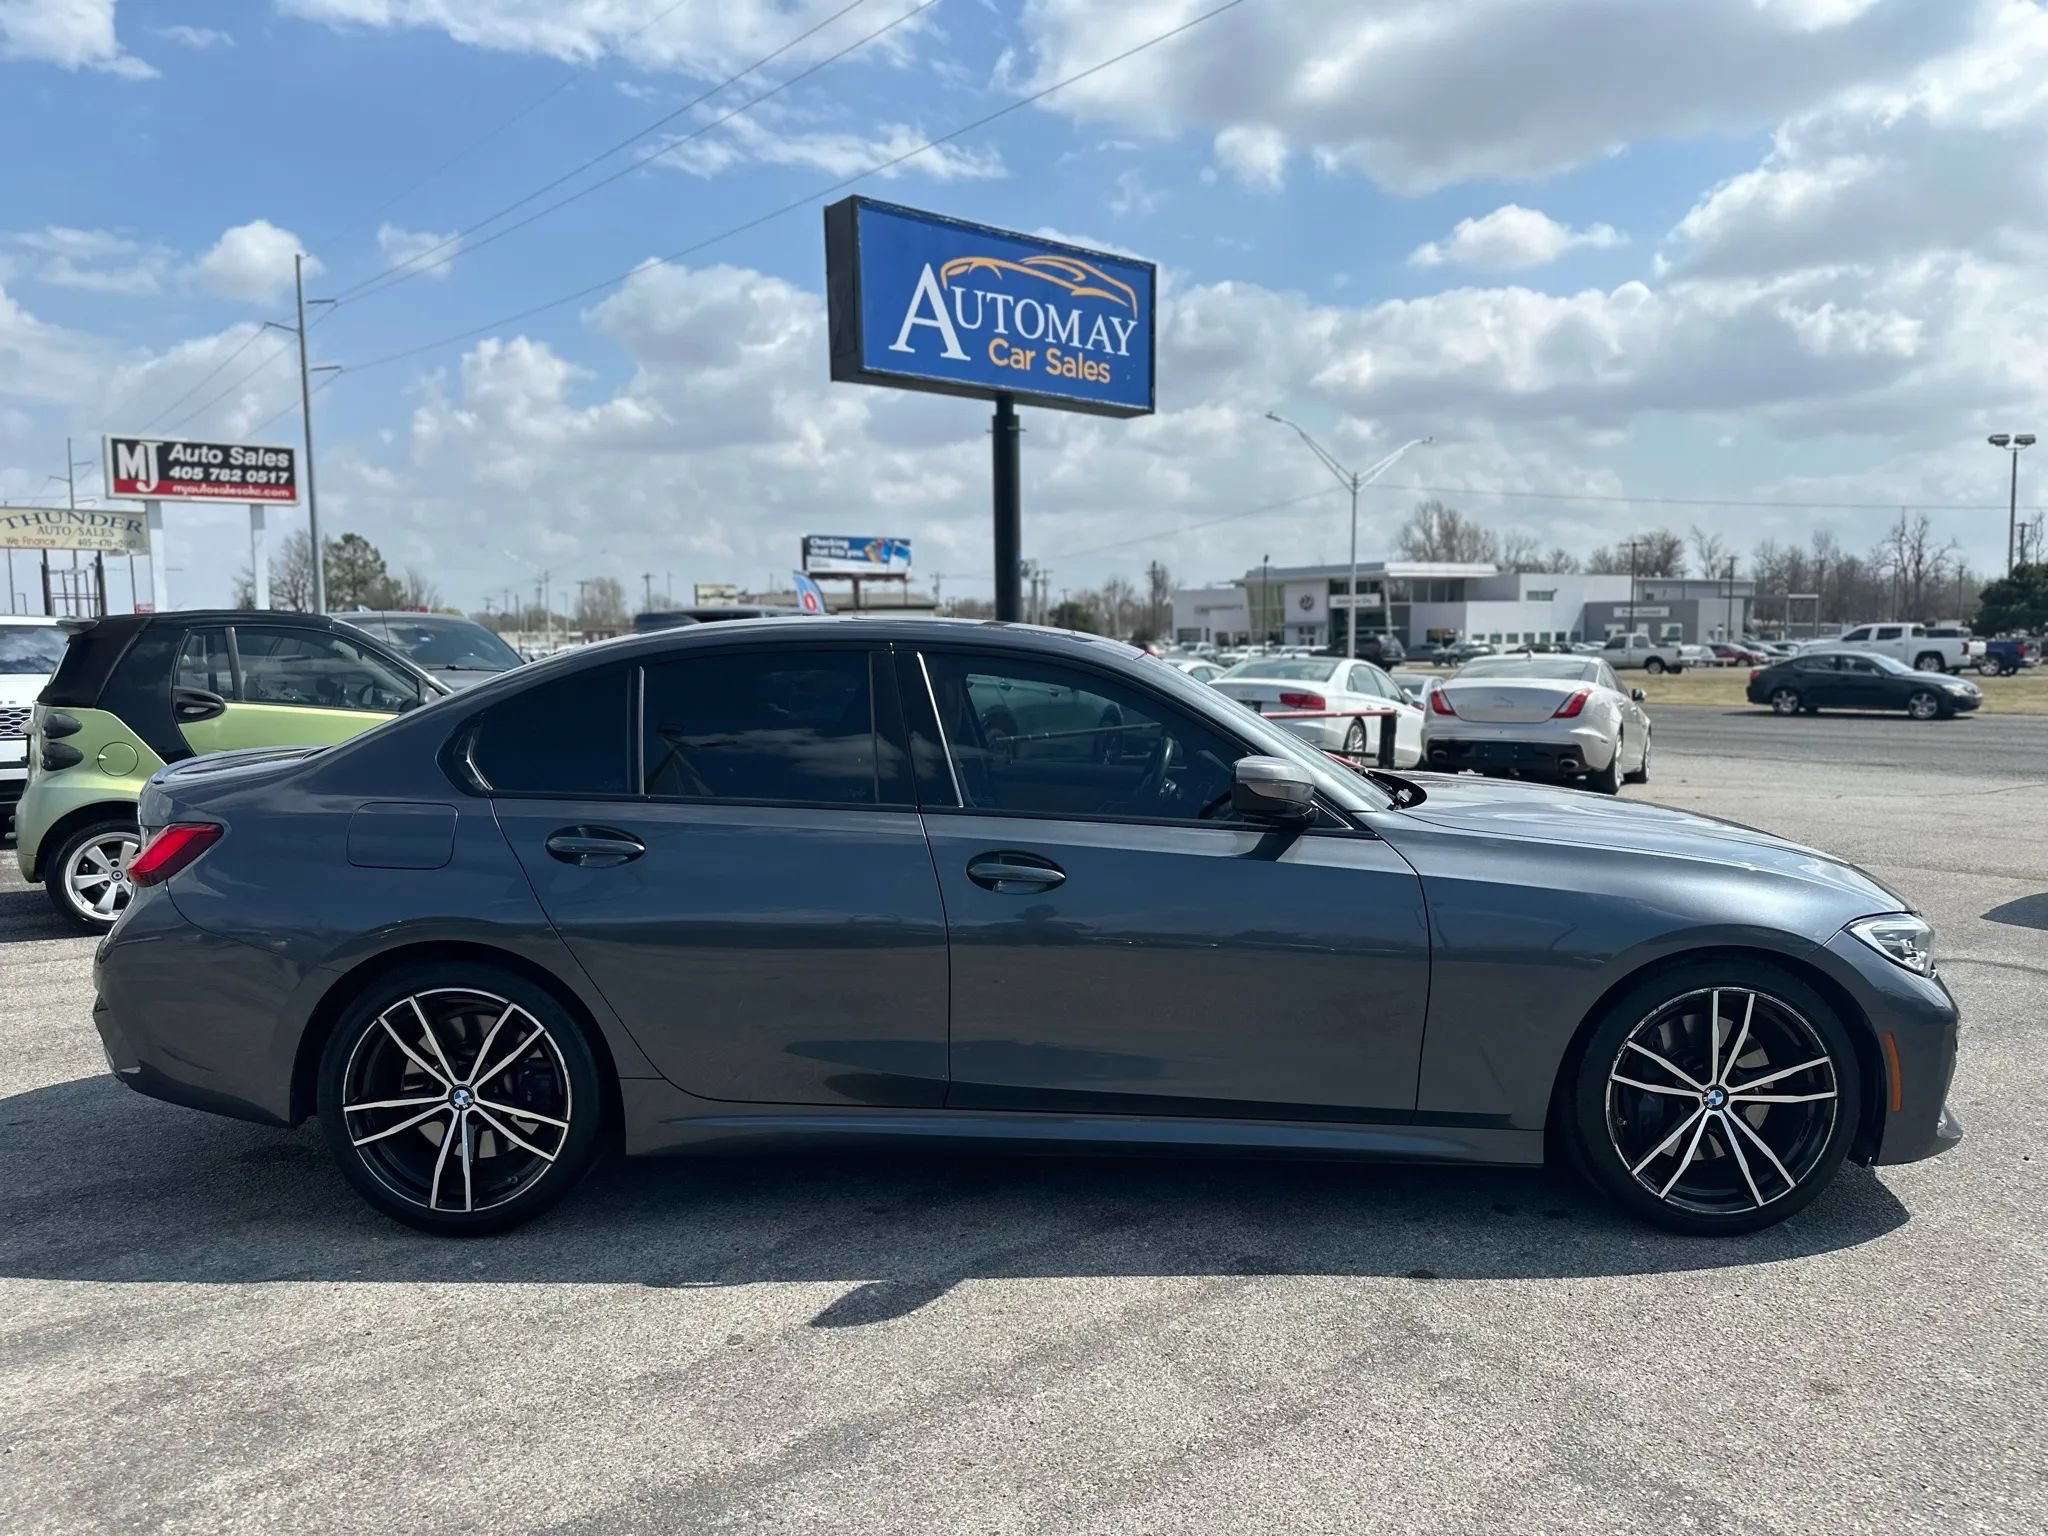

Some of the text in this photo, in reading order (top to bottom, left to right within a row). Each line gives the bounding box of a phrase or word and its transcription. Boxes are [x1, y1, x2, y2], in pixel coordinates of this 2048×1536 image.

[889, 263, 1138, 361] AUTOMAY
[988, 338, 1111, 384] Car Sales
[116, 441, 165, 492] MJ
[168, 443, 289, 467] Auto Sales
[169, 466, 290, 484] 405 782 0517
[0, 511, 142, 533] THUNDER
[37, 526, 114, 537] AUTO SALES
[5, 536, 56, 546] We Finance
